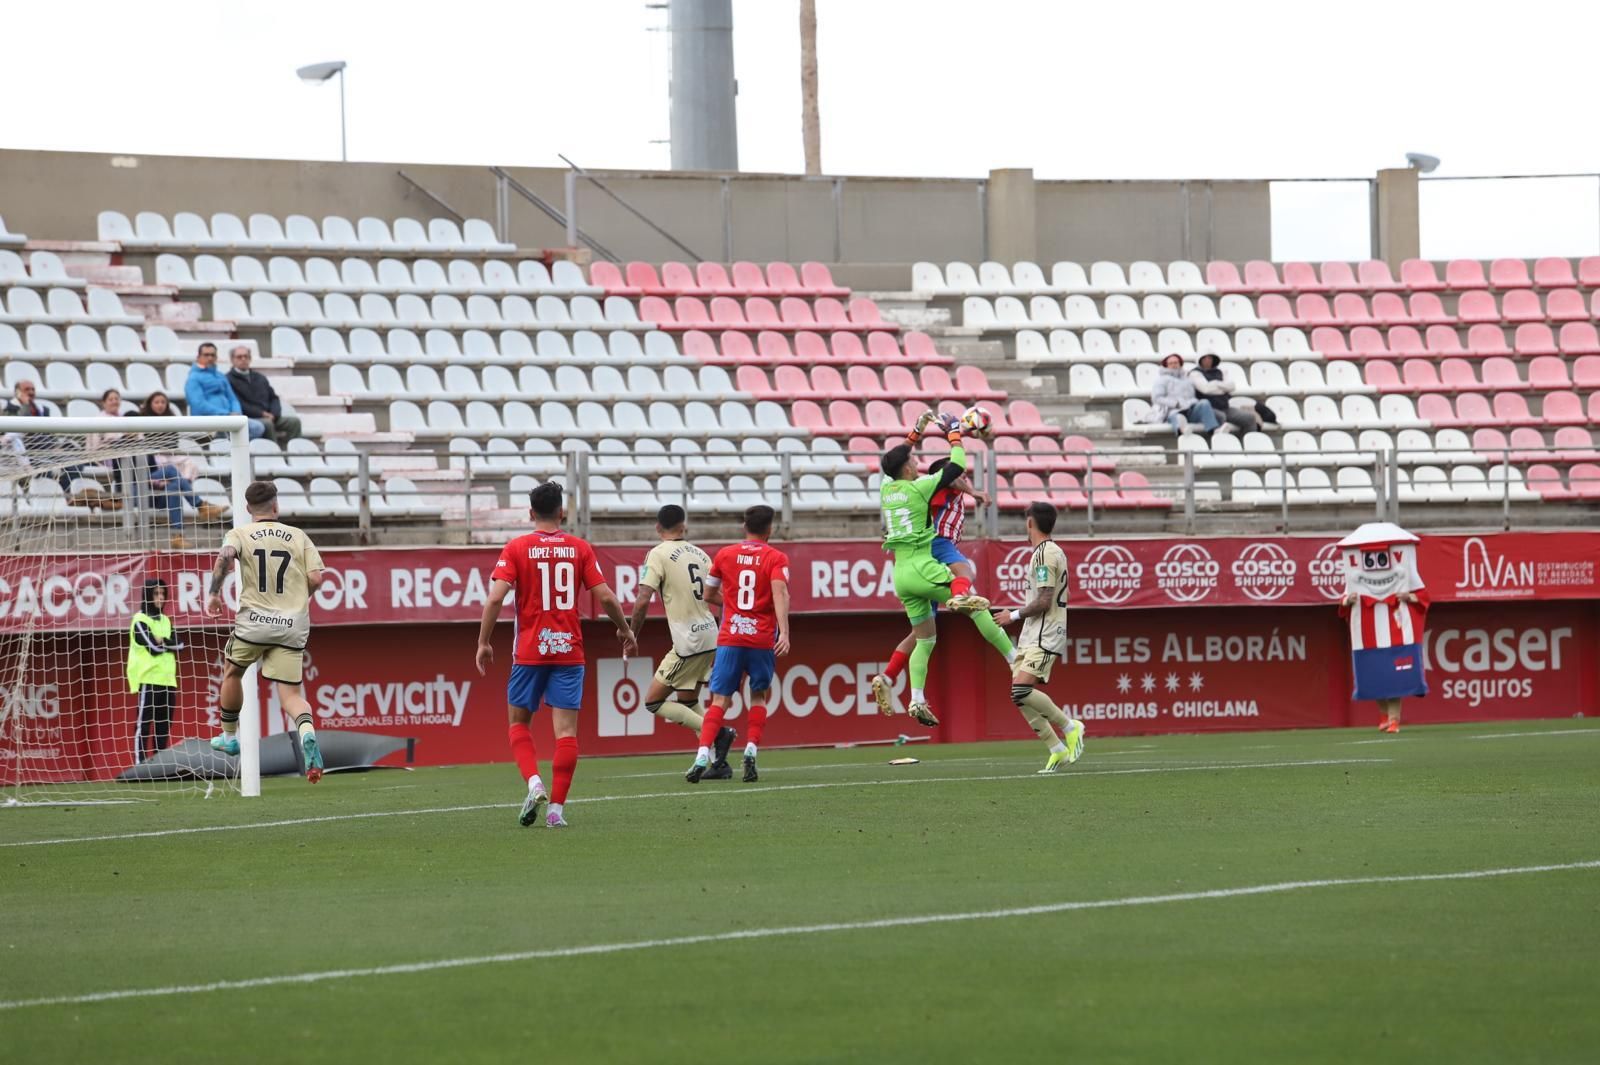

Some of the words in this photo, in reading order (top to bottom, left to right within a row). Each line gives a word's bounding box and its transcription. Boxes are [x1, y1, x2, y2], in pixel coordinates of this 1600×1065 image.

[250, 528, 293, 542] ESTACIO
[252, 549, 292, 594] 17
[1076, 562, 1143, 579] COSCO
[1155, 560, 1220, 577] COSCO
[1231, 559, 1297, 576] COSCO
[1308, 560, 1345, 575] COS
[537, 562, 575, 611] 19
[688, 563, 704, 601] 5
[1079, 578, 1141, 589] SHIPPING
[1157, 577, 1218, 588] SHIPPING
[1234, 575, 1295, 586] SHIPPING
[737, 570, 756, 611] 8
[249, 611, 294, 628] Greening
[1060, 637, 1152, 664] TELES
[1161, 627, 1306, 663] ALBORÁN
[316, 674, 472, 726] servicity
[1442, 678, 1533, 707] seguros
[1061, 702, 1158, 720] ALGECIRAS
[1172, 700, 1260, 718] CHICLANA
[321, 716, 394, 728] PROFESIONALES
[395, 716, 408, 726] EN
[409, 716, 421, 725] TU
[422, 714, 452, 725] HOGAR
